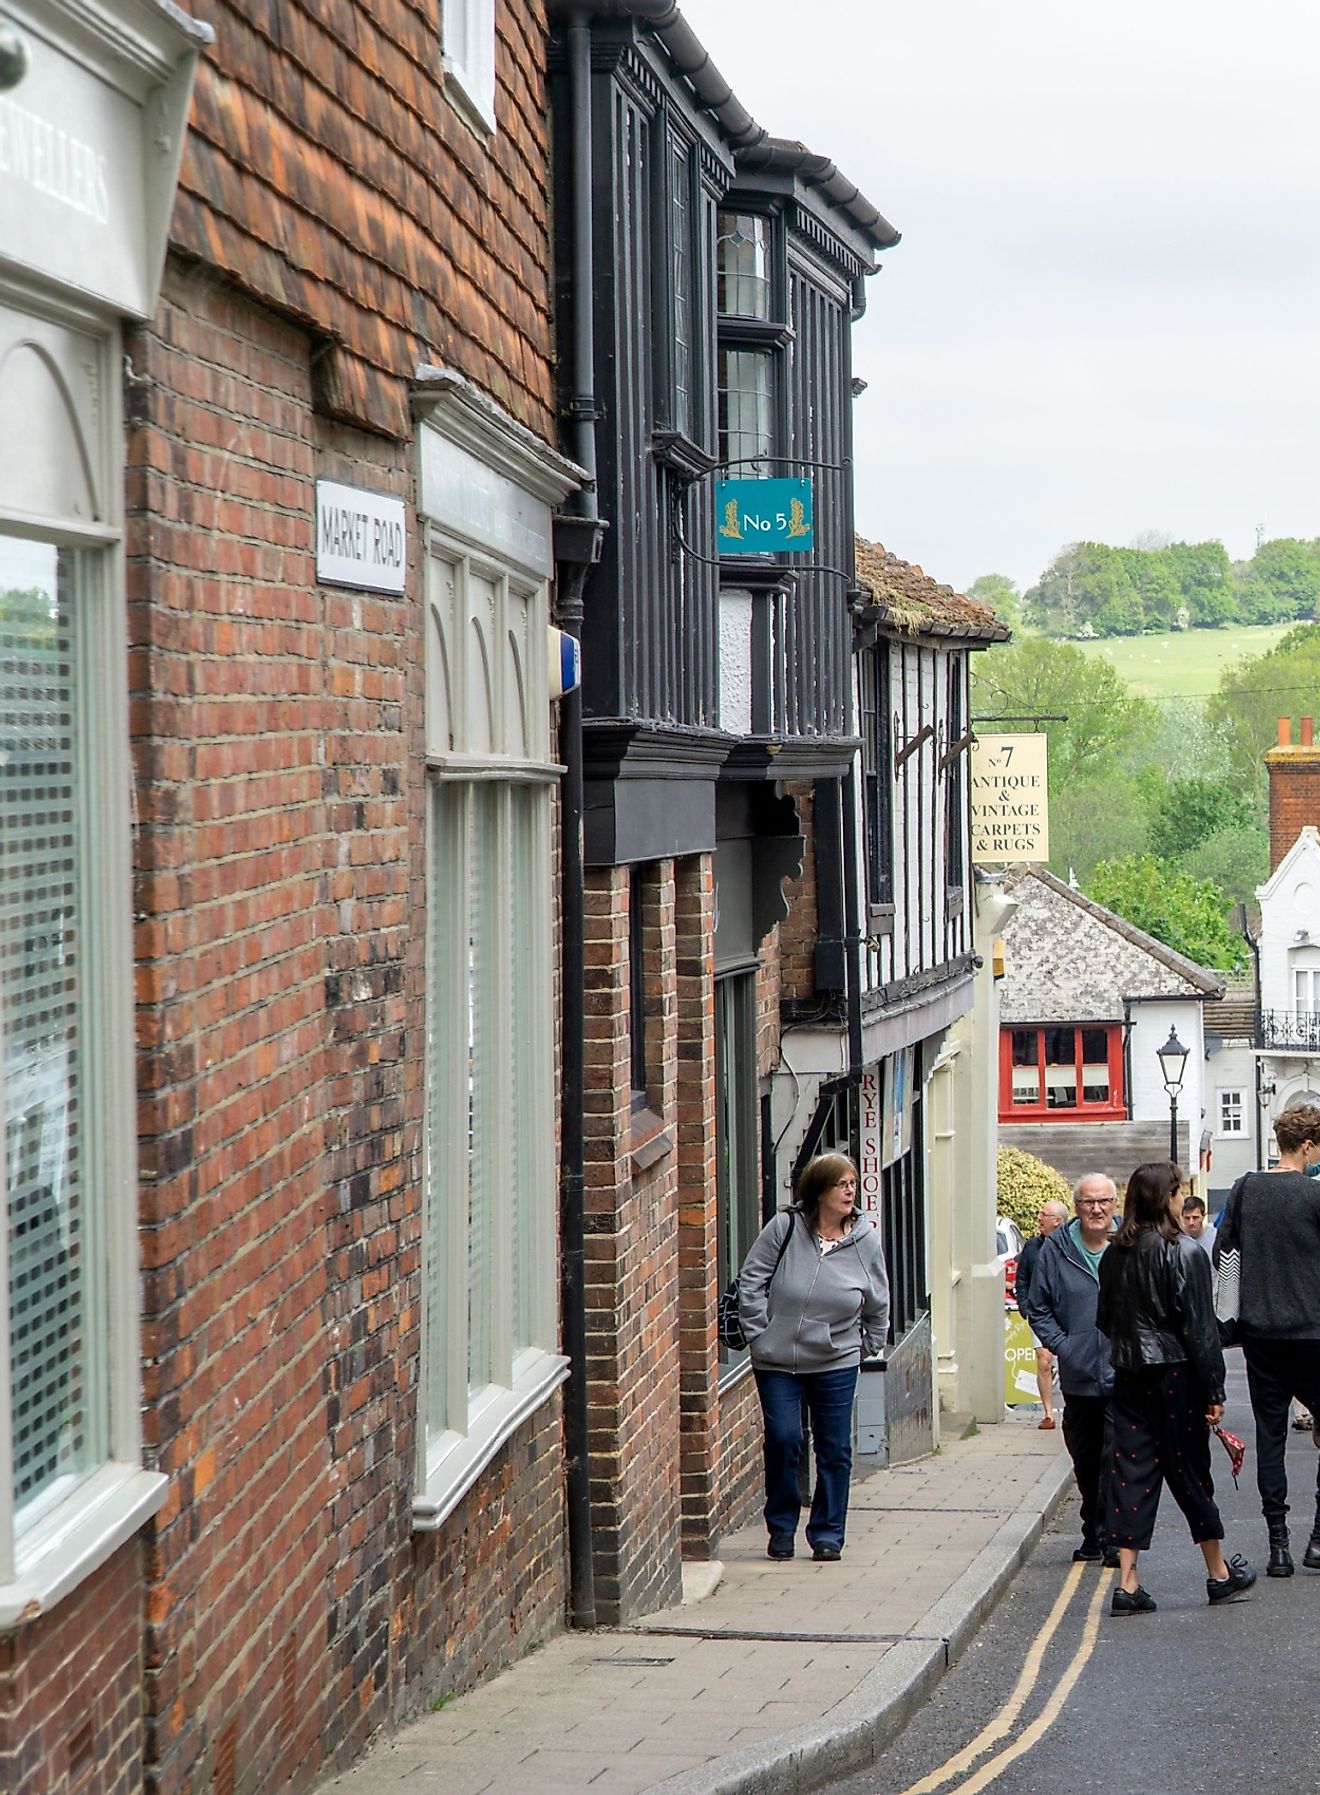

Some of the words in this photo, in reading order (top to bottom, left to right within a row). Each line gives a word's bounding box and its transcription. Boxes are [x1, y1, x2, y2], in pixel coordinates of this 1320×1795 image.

[743, 514, 771, 531] No
[776, 513, 787, 530] 5
[322, 505, 368, 561] MARKET
[373, 518, 402, 567] ROAD
[1001, 746, 1013, 767] 7
[972, 775, 1040, 789] ANTIQUE
[998, 789, 1010, 801] &
[972, 804, 1039, 816] VINTAGE
[972, 823, 1041, 836] CARPETS
[976, 839, 988, 851] &
[993, 838, 1035, 851] RUGS
[862, 1074, 877, 1128] RYE
